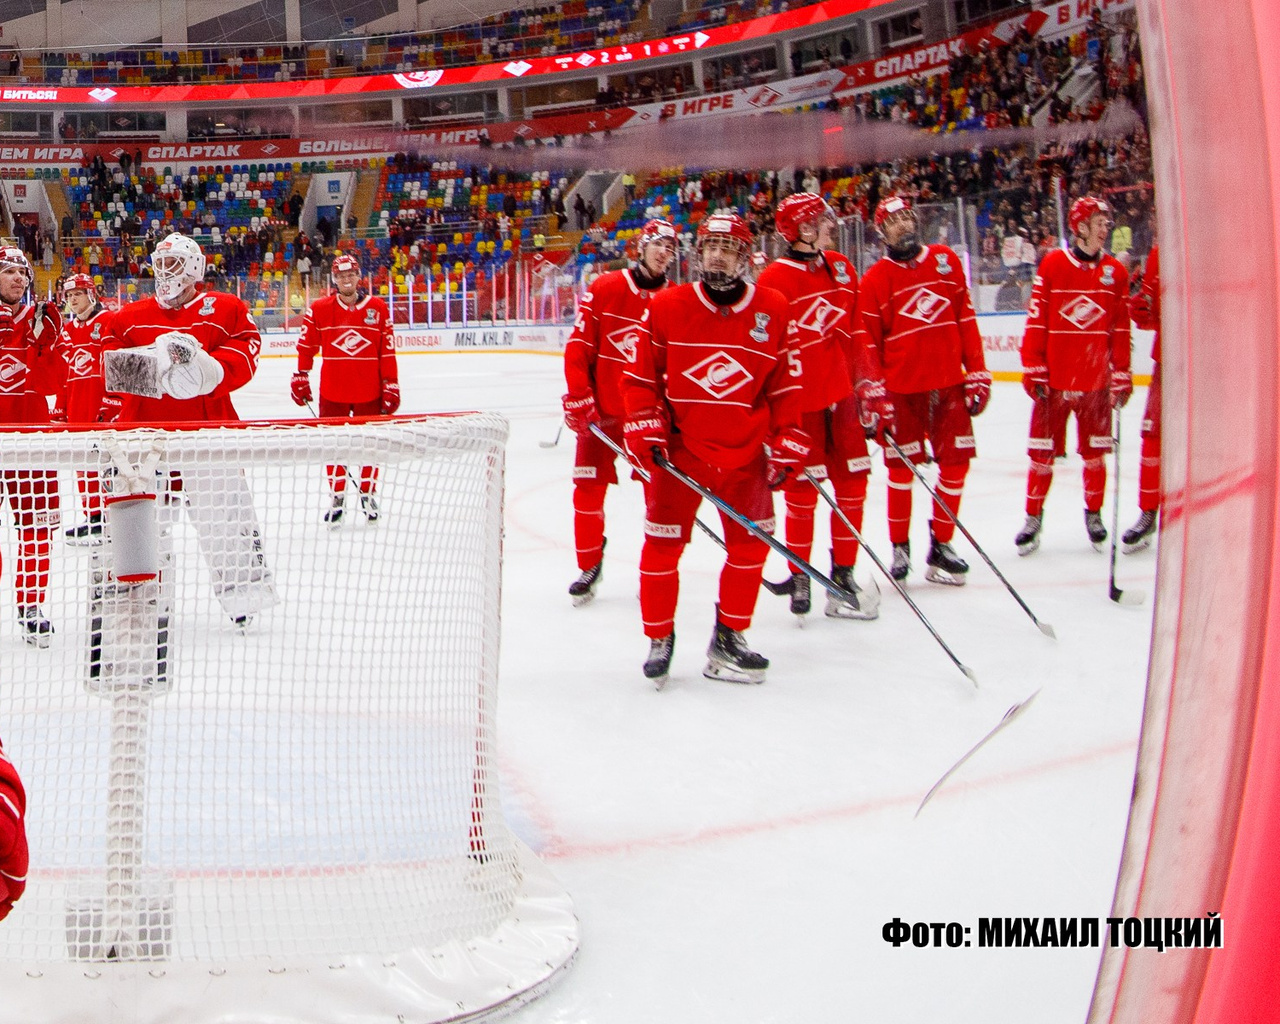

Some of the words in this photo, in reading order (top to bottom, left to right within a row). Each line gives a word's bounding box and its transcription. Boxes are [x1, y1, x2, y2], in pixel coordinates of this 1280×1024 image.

[1057, 4, 1071, 25] В
[600, 51, 609, 63] 2
[874, 38, 964, 78] СПАРТАК
[3, 89, 58, 100] БИТЬСЯ!
[682, 93, 735, 117] ИГРЕ
[148, 144, 241, 159] СПАРТАК
[299, 136, 390, 154] БОЛЬШЕ,
[33, 147, 85, 160] ИГРА
[405, 335, 442, 347] ПОБЕДА!
[454, 331, 515, 347] MHL.KHL.RU
